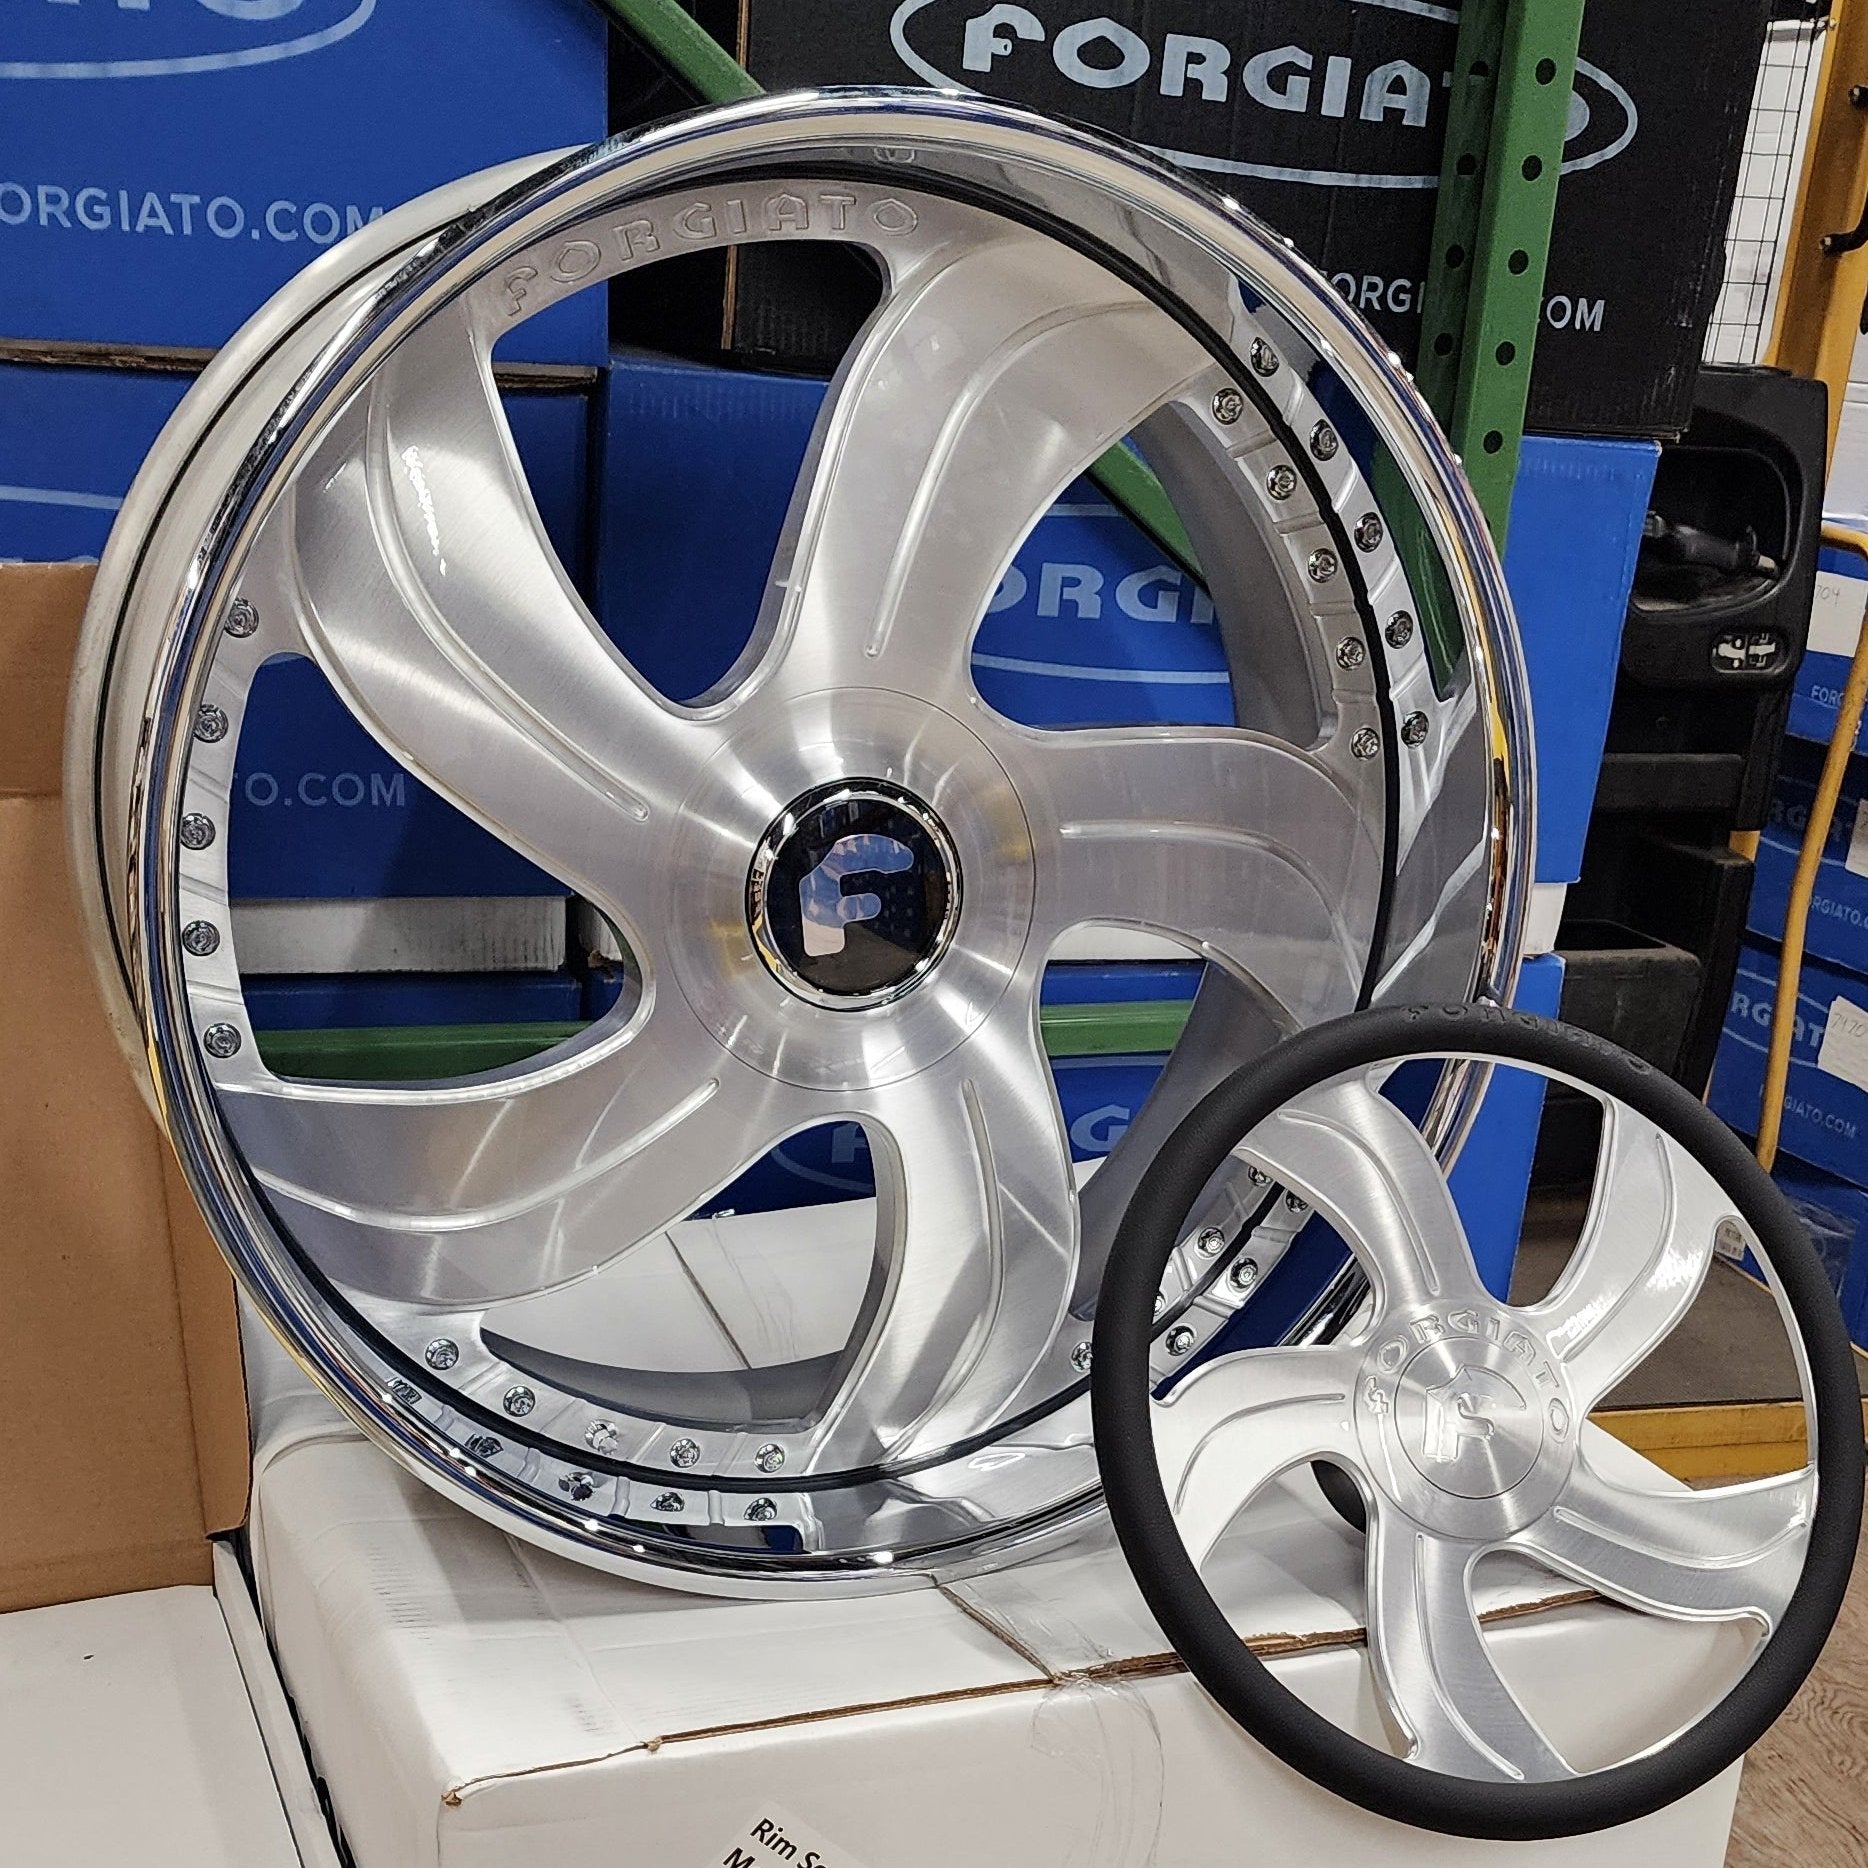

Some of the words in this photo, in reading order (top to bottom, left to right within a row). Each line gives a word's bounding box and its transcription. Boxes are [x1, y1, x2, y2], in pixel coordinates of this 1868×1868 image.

[962, 3, 1590, 142] FORGIA
[504, 192, 920, 317] FORGIATO
[234, 772, 405, 807] O.COM
[798, 833, 915, 957] F
[1363, 1309, 1570, 1444] FORGIATO
[750, 1818, 797, 1860] Rim
